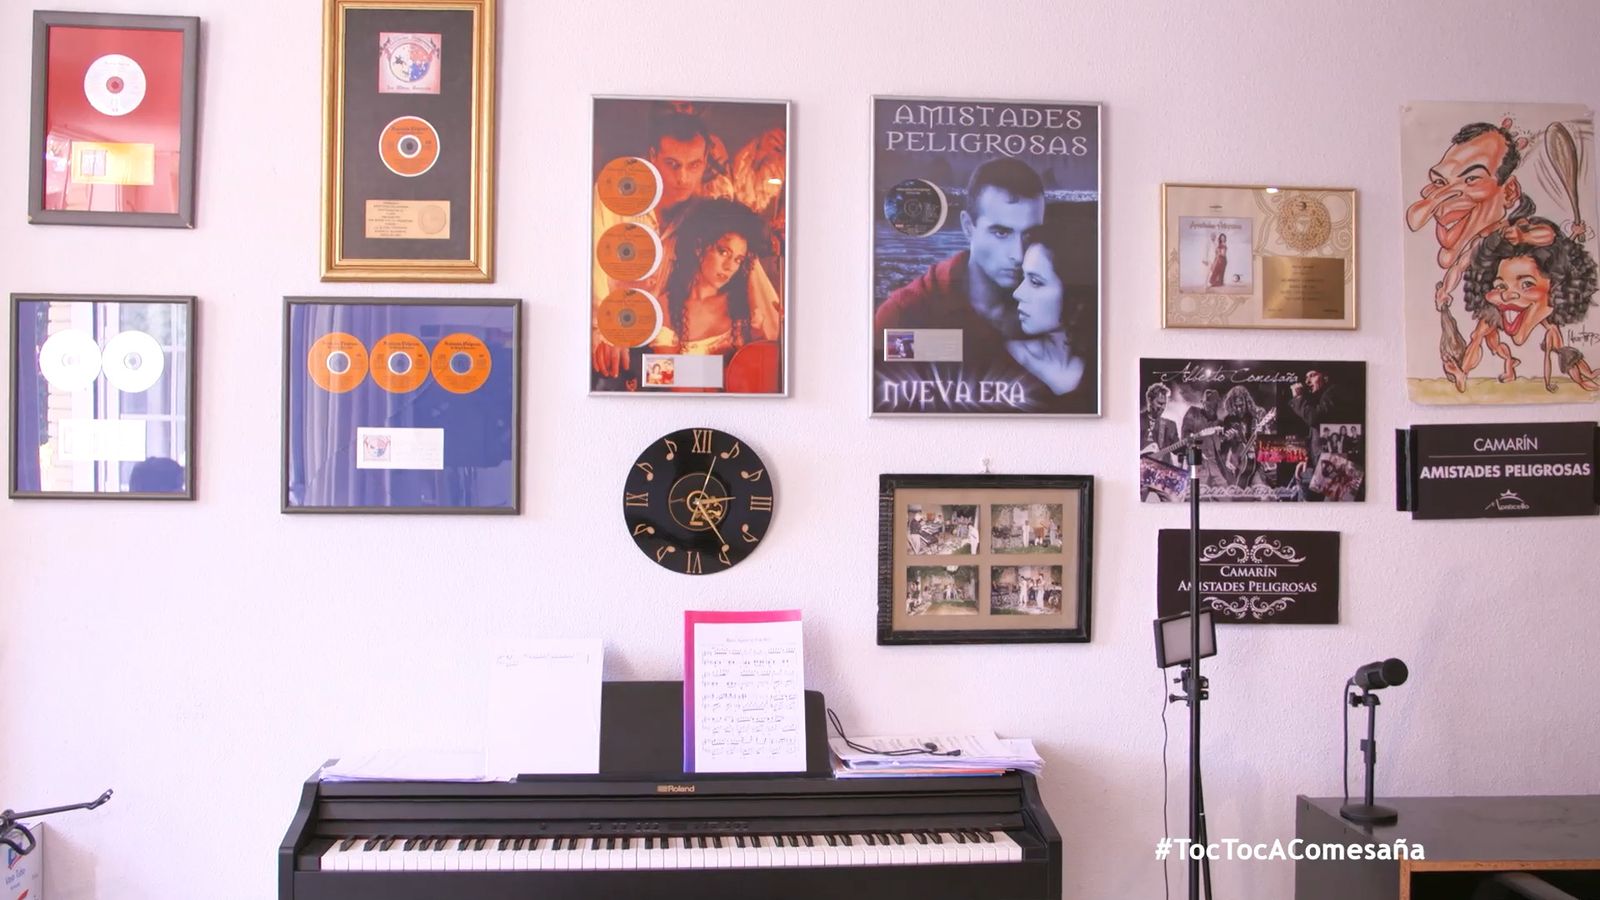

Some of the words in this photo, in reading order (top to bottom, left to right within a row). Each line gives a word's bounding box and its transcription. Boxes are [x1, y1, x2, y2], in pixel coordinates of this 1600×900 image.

[892, 104, 1082, 130] AMISTADES
[885, 131, 1088, 158] PELIGROSAS
[1153, 361, 1226, 383] Alberto
[1230, 367, 1299, 384] Comesaña
[883, 379, 972, 408] NUEVA
[979, 379, 1026, 407] ERA
[692, 429, 713, 454] XII
[1473, 434, 1538, 452] CAMARÍN
[1419, 464, 1501, 480] AMISTADES
[1504, 462, 1591, 478] PELIGROSAS
[667, 784, 695, 793] Roland
